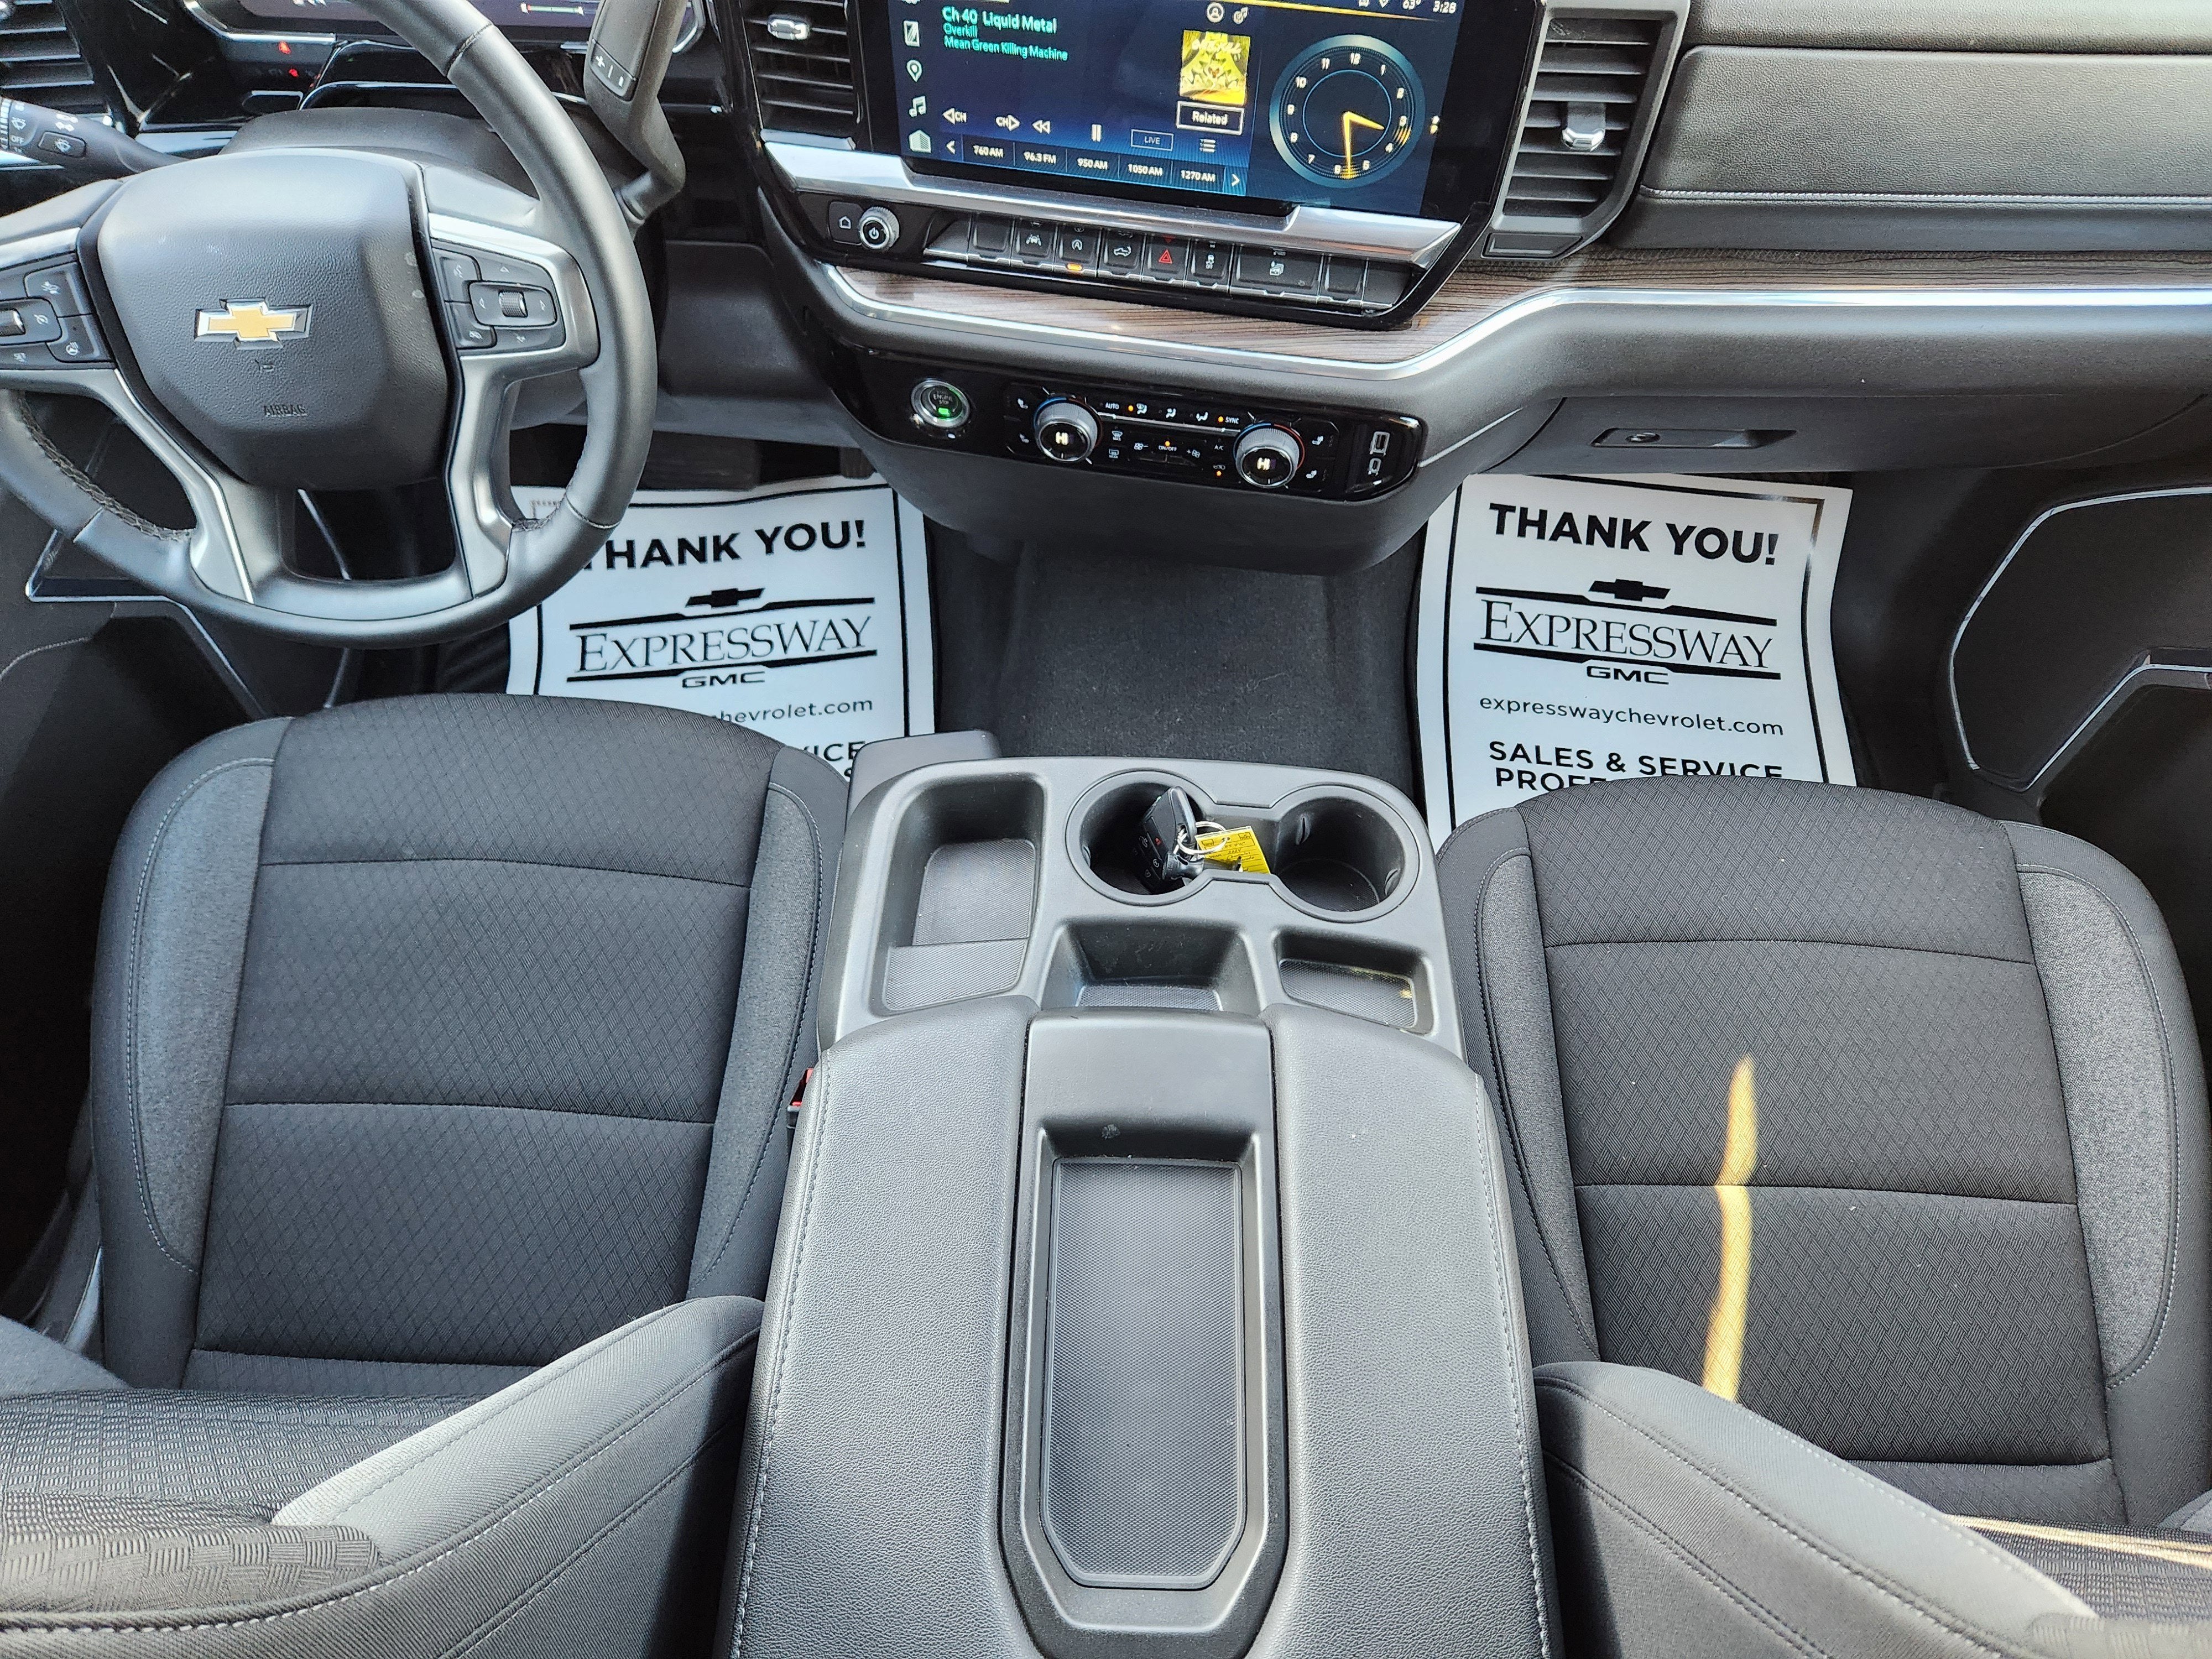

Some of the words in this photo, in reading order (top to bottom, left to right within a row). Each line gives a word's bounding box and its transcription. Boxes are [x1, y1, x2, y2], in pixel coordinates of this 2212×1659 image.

[1432, 0, 1457, 14] 3:28
[942, 6, 960, 23] Ch
[962, 8, 978, 24] 40
[982, 11, 1020, 31] Liquid
[1021, 15, 1057, 34] Metal
[943, 22, 978, 38] Overkill
[943, 35, 971, 50] Mean
[971, 38, 1000, 53] Green
[1000, 41, 1028, 59] Killing
[1029, 44, 1068, 61] Machine
[954, 111, 967, 123] CH
[995, 116, 1009, 128] CH
[1192, 109, 1229, 126] Related
[11, 135, 24, 144] OFF
[1144, 135, 1161, 145] LIVE
[989, 147, 1004, 159] AM
[1024, 151, 1042, 163] 96.3
[1042, 153, 1057, 164] FM
[1077, 157, 1094, 169] 950
[1094, 160, 1108, 170] AM
[1128, 164, 1148, 175] 1050
[1148, 166, 1164, 177] AM
[1181, 170, 1201, 181] 1270
[1201, 173, 1216, 183] AM
[264, 404, 308, 418] AIRBAG
[1055, 431, 1069, 445] HI
[1256, 457, 1271, 471] HI
[1489, 502, 1652, 552] THANK
[1665, 522, 1779, 566] YOU!
[583, 532, 742, 570] HANK
[755, 520, 865, 555] YOU!
[681, 670, 766, 688] GMC
[1586, 665, 1670, 685] GMC
[712, 700, 873, 723] hevrolet.com
[1479, 696, 1785, 737] expresswaychevrolet.com
[1489, 740, 1594, 769] SALES
[1606, 752, 1626, 773] &
[1639, 755, 1783, 779] SERVICE
